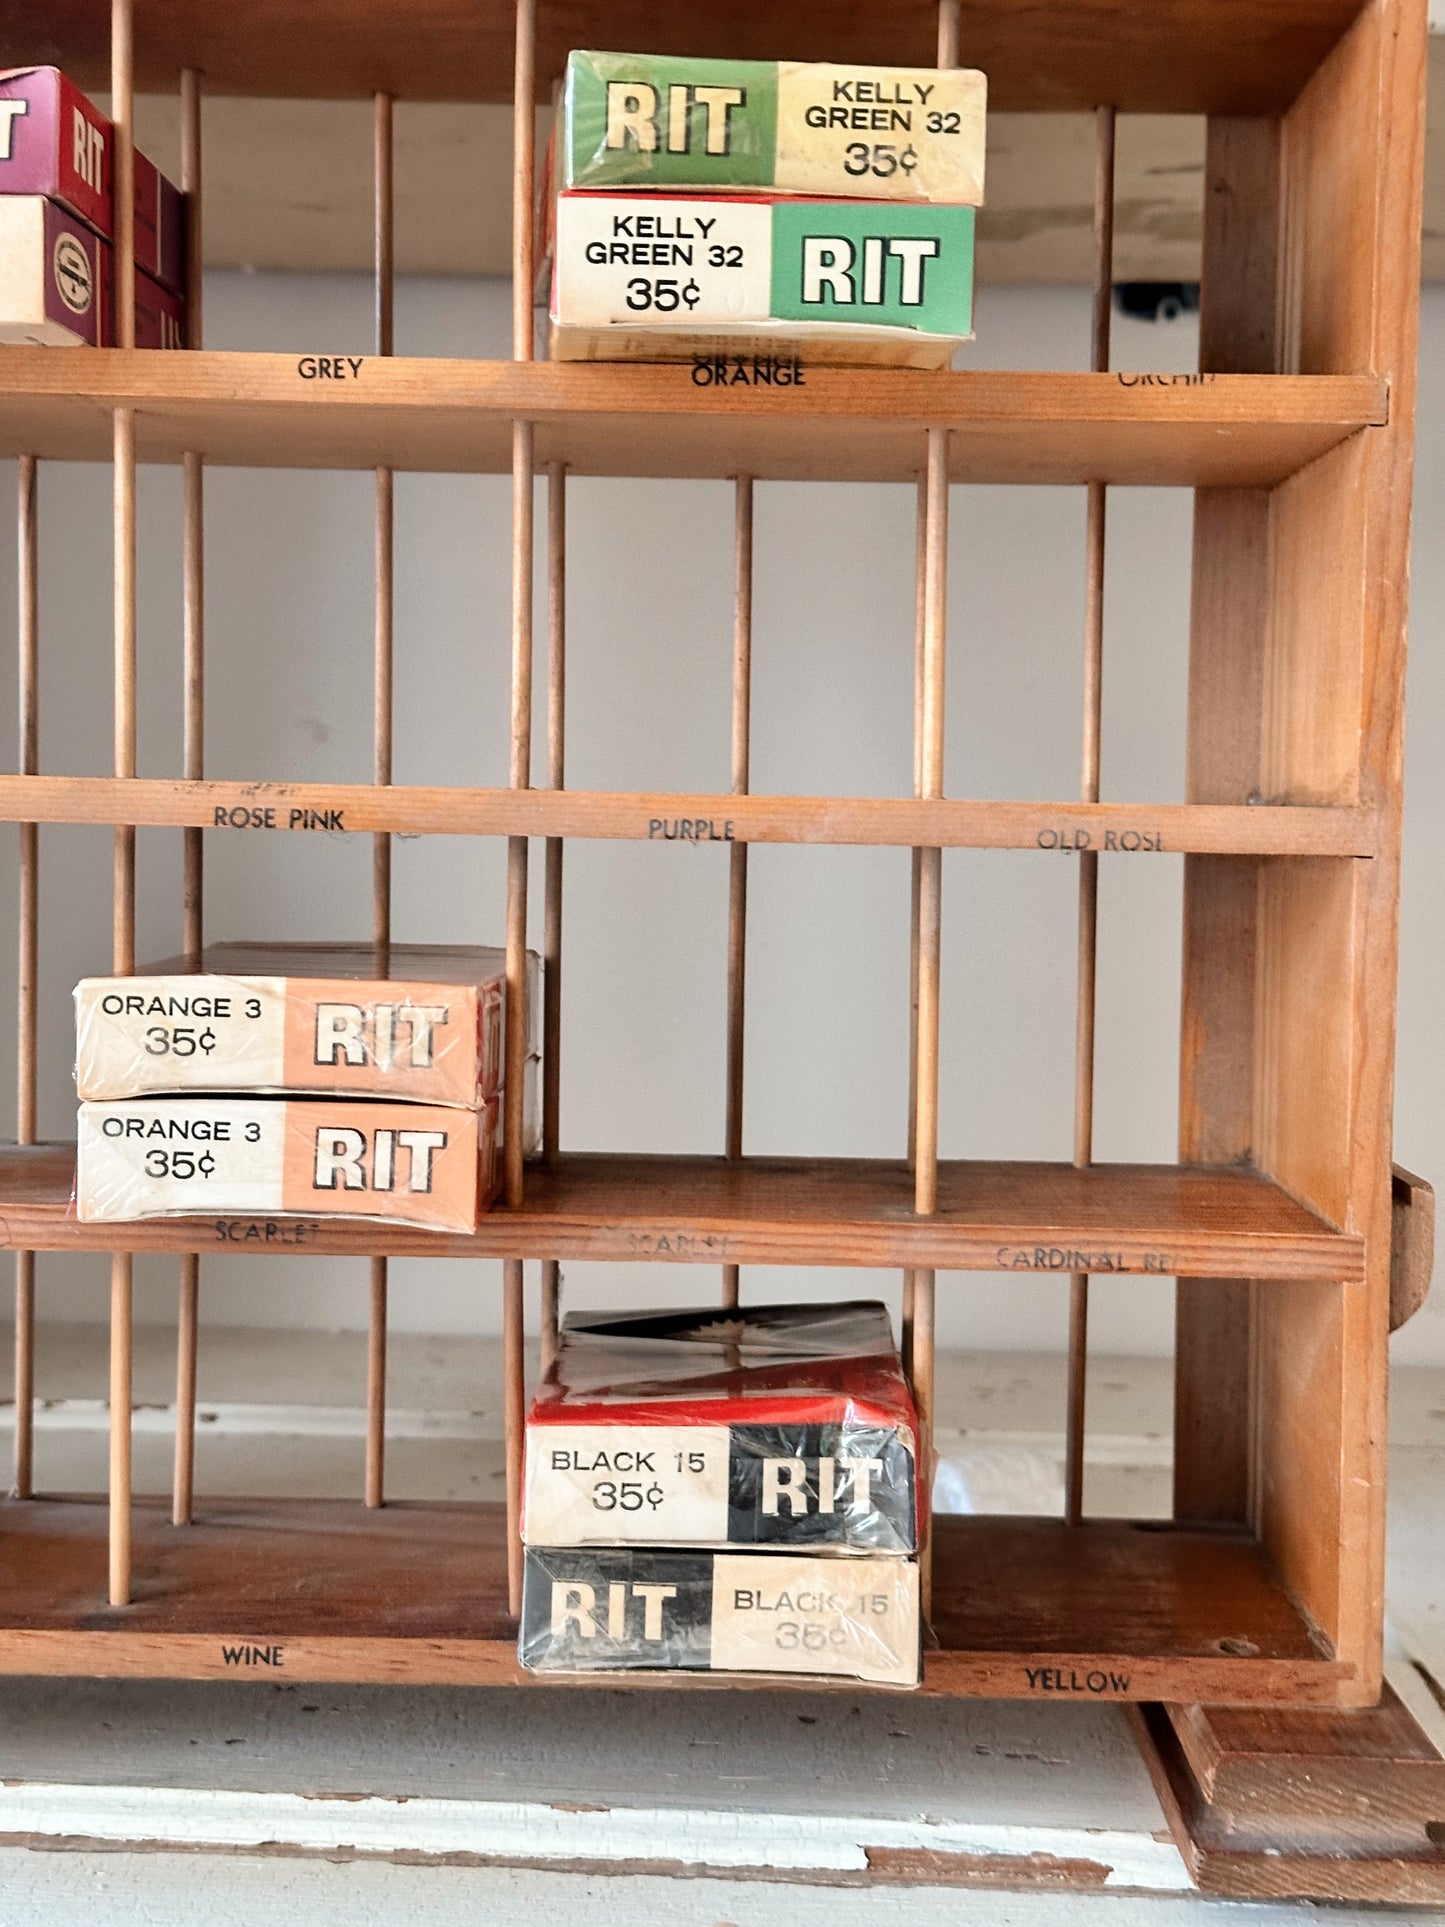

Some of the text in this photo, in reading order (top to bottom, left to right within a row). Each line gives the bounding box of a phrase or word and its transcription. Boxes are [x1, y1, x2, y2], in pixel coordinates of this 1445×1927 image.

[833, 80, 934, 105] KELLY
[605, 80, 747, 157] RIT
[805, 106, 961, 134] GREEN 32
[73, 105, 105, 195] RIT
[843, 143, 918, 177] 35¢
[613, 215, 716, 239] KELLY
[585, 242, 744, 268] GREEN 32
[800, 234, 940, 307] RIT
[626, 278, 701, 311] 35¢
[298, 357, 363, 379] GREY
[691, 362, 805, 387] ORANGE
[214, 806, 345, 831] ROSE PINK
[649, 818, 735, 841] PURPLE
[1037, 828, 1091, 850] OLD
[102, 995, 262, 1019] ORANGE 3
[145, 1027, 217, 1056] 35¢
[313, 1002, 449, 1069] RIT
[102, 1117, 262, 1142] ORANGE 3
[145, 1149, 216, 1179] 35¢
[312, 1125, 448, 1194] RIT
[997, 1247, 1175, 1273] CARDINAL RE
[551, 1450, 705, 1473] BLACK 15
[592, 1481, 664, 1511] 35¢
[761, 1456, 884, 1517] RIT
[550, 1580, 677, 1641] RIT
[734, 1588, 889, 1616] BLACK 15
[222, 1645, 284, 1666] WINE
[1025, 1667, 1131, 1693] YELLOW
